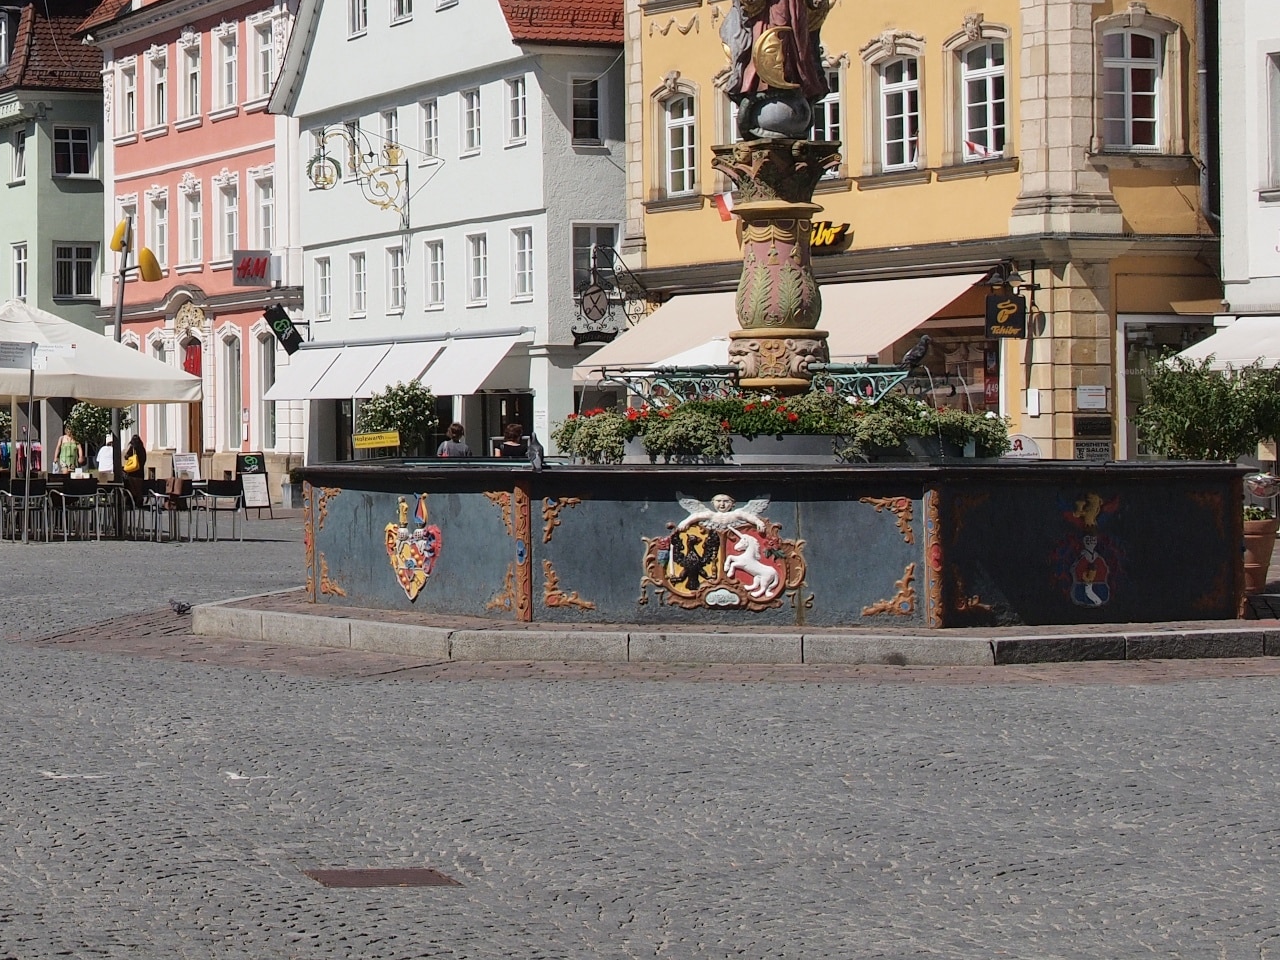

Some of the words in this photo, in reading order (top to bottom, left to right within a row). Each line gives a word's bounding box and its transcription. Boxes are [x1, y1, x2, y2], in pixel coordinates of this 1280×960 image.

[810, 221, 843, 246] ibo
[237, 257, 268, 279] H&M
[990, 325, 1022, 335] Tchibo
